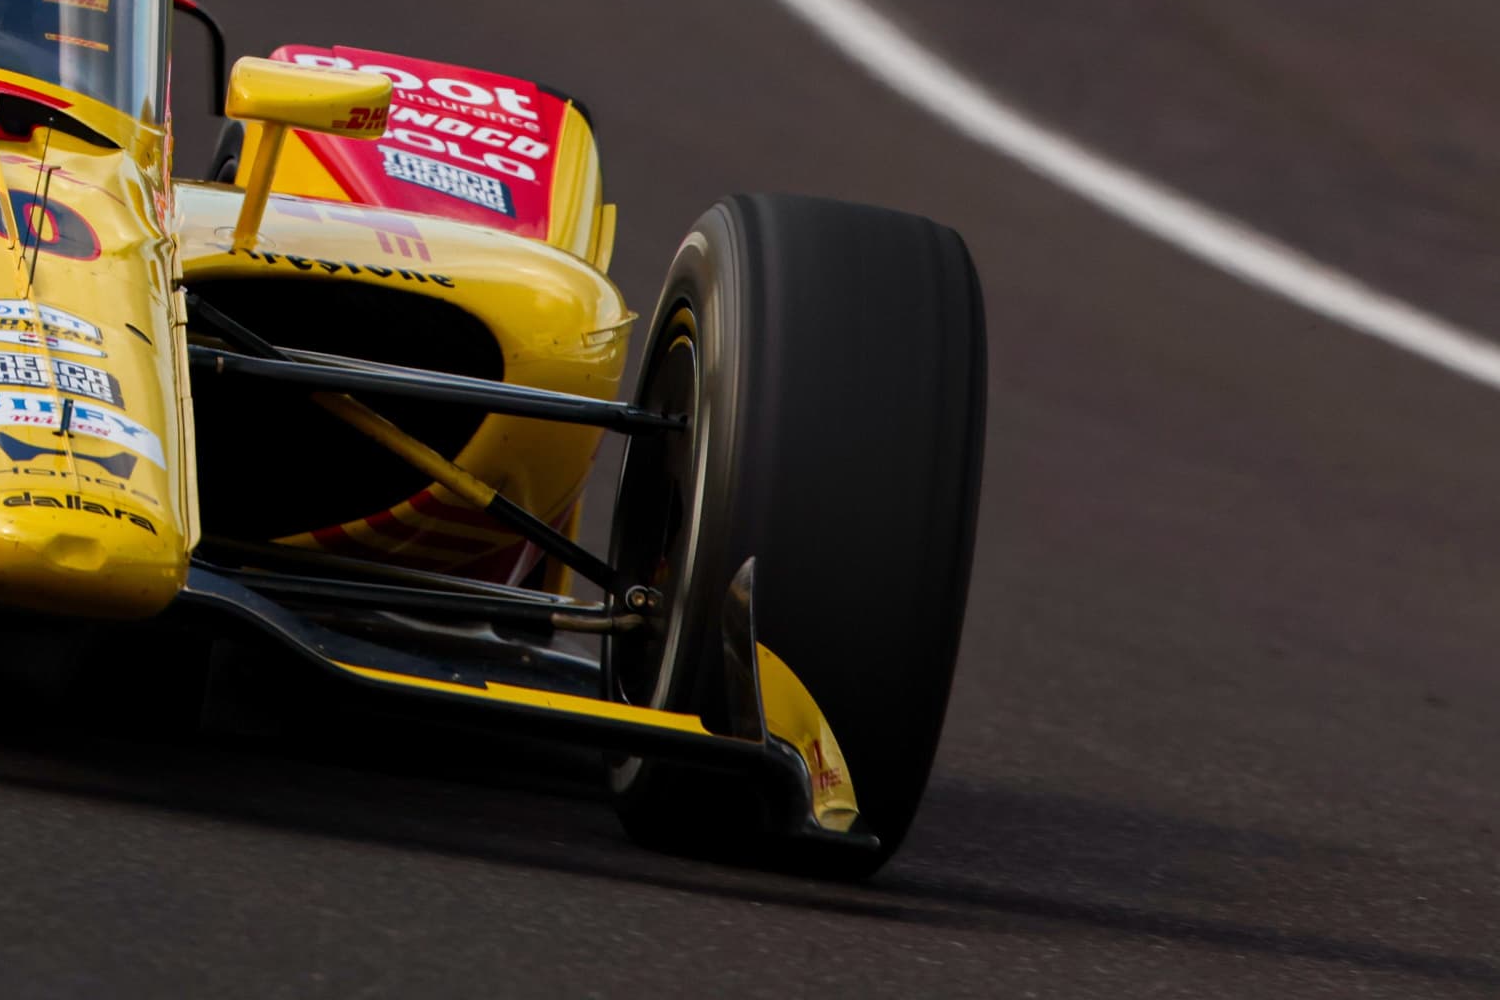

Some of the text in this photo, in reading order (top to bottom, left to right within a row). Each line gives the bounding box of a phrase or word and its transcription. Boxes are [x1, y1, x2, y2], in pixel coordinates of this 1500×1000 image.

[382, 128, 536, 181] OLO
[388, 104, 549, 159] NOCO
[380, 150, 503, 196] TRENCH
[3, 492, 158, 536] dallara
